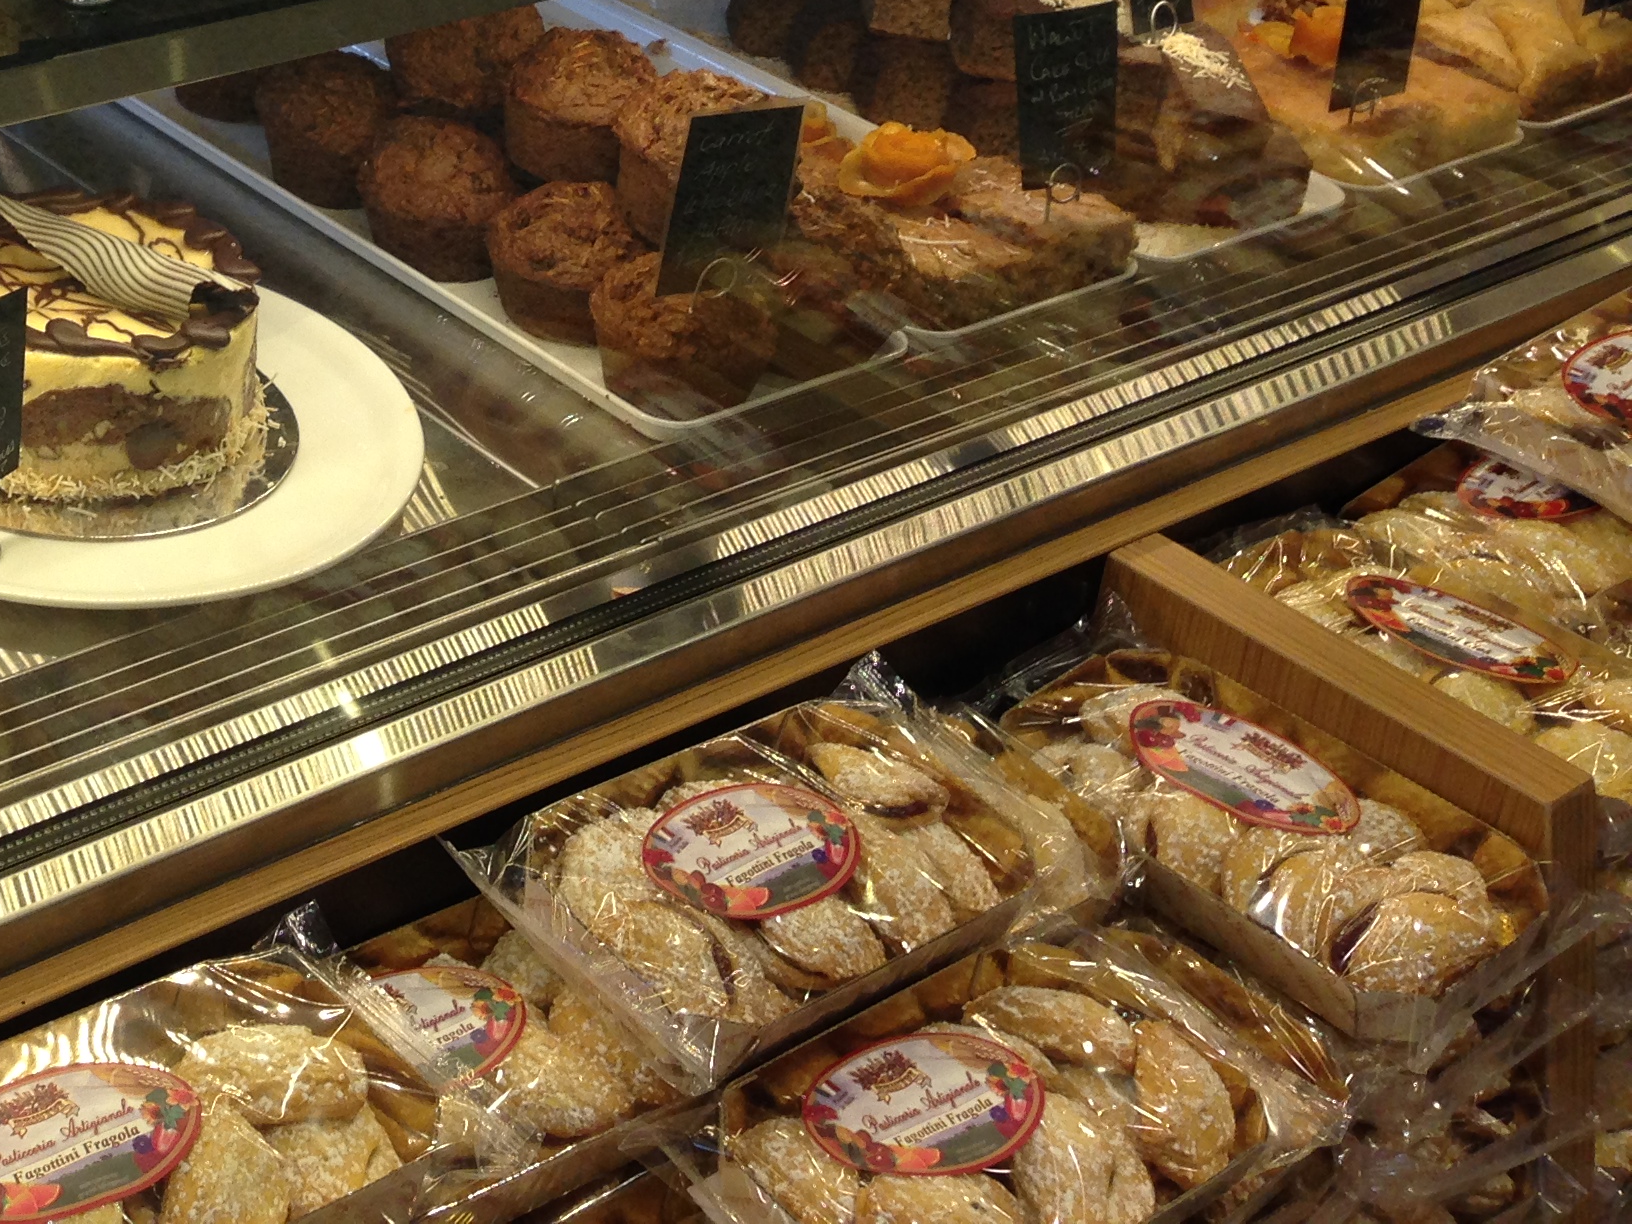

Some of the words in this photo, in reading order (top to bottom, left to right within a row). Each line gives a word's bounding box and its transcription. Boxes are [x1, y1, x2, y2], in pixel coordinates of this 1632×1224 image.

[696, 848, 750, 874] Pasticceria
[725, 857, 775, 888] Fagottini
[774, 839, 815, 864] Fragola
[434, 1021, 476, 1045] ragola
[60, 1098, 135, 1142] Artigianale
[862, 1105, 921, 1135] Pasticceria
[921, 1071, 981, 1112] Artigianale
[893, 1117, 947, 1149] Fagottini
[948, 1097, 994, 1125] Fragola
[13, 1148, 81, 1184] Fagottini
[83, 1124, 142, 1154] Fragola
